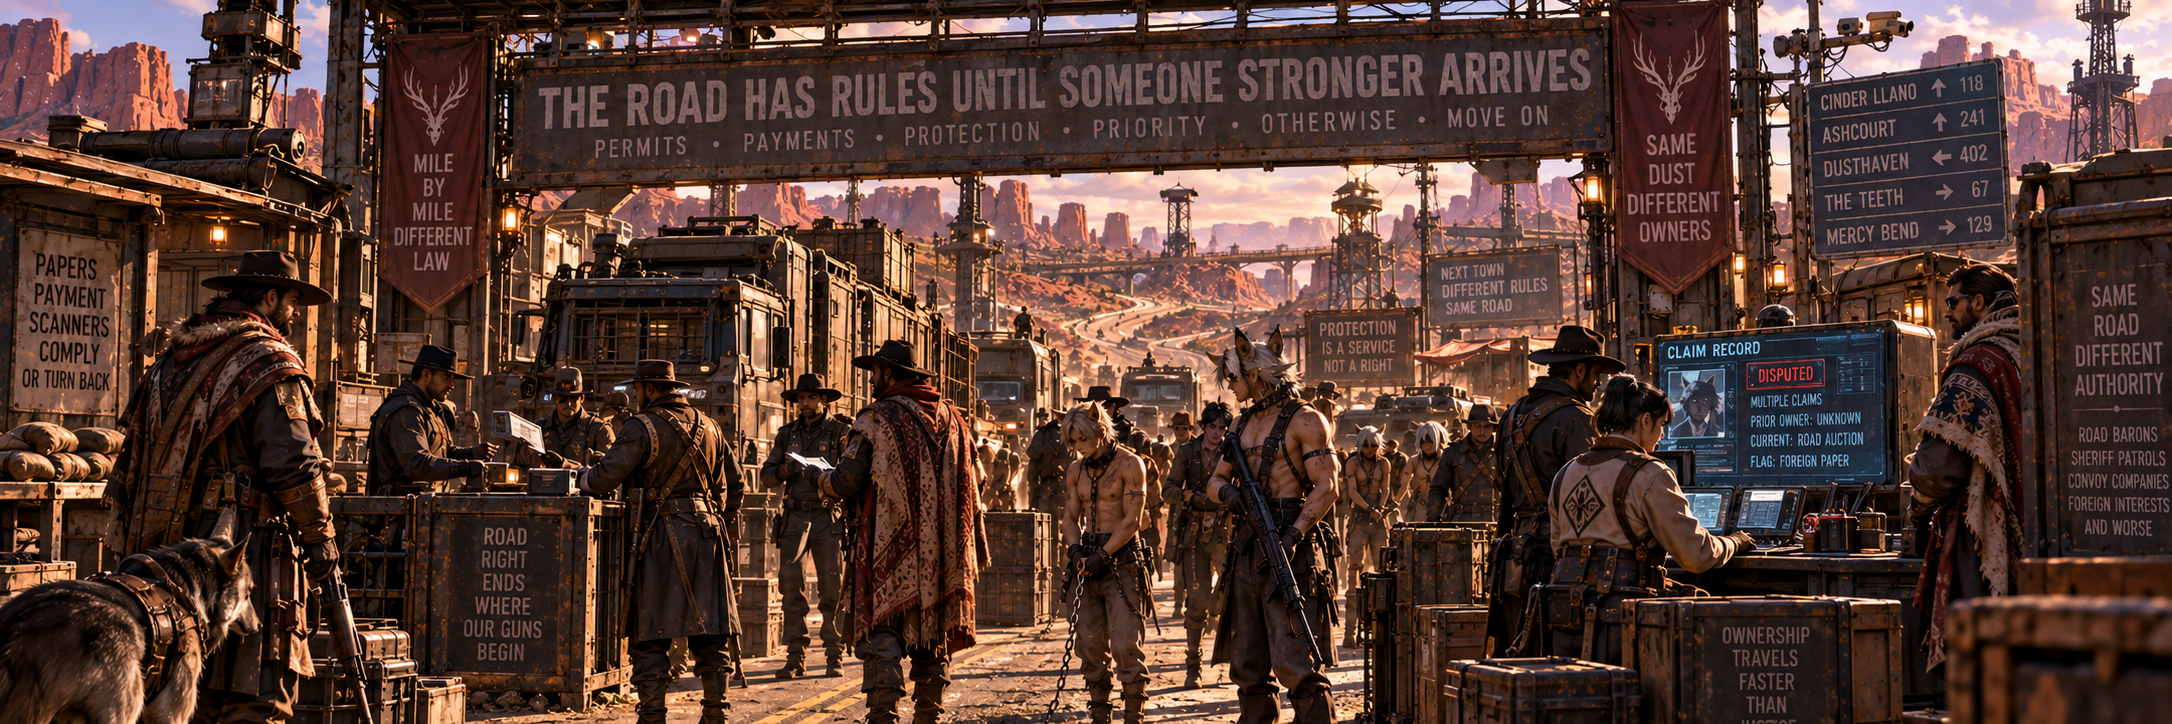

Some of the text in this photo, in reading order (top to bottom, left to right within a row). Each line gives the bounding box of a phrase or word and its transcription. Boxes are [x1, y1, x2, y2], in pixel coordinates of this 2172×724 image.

[538, 48, 1591, 129] THE ROAD HAS RULES UNTIL SOMEONE STRONGER ARRIVES
[1821, 75, 1983, 111] CINDER LLANO 118
[595, 105, 1548, 158] PERMITS PAYMENTS PROTECTION PRIORITY OTHERWISE MOVE ON
[1822, 109, 1984, 143] ASHCOURT 241
[1647, 133, 1696, 156] SAME
[414, 153, 453, 173] MILE
[1824, 144, 1988, 177] DUSTHAVEN 402
[1649, 162, 1695, 185] DUST
[423, 178, 445, 197] BY
[1825, 180, 1989, 212] THE TEETH 67
[413, 202, 453, 221] MILE
[1627, 191, 1720, 215] DIFFERENT
[394, 227, 472, 246] DIFFERENT
[1640, 220, 1711, 242] OWNERS
[1827, 215, 1992, 245] MERCY BEND 129
[36, 253, 97, 280] PAPERS
[414, 252, 450, 271] LAW
[1441, 263, 1504, 280] NEXT TOWN
[34, 283, 106, 309] PAYMENT
[1442, 277, 1547, 298] DIFFERENT RULES
[2091, 284, 2137, 307] SAME
[1446, 298, 1512, 315] SAME ROAD
[29, 311, 109, 337] SCANNERS
[1320, 320, 1396, 336] PROTECTION
[2094, 313, 2139, 337] ROAD
[40, 341, 100, 364] COMPLY
[1322, 340, 1395, 354] IS A SERVICE
[1667, 341, 1760, 359] CLAIM RECORD
[2075, 342, 2163, 367] DIFFERENT
[1324, 359, 1393, 373] NOT A RIGHT
[1758, 366, 1814, 383] DISPUTED
[22, 368, 110, 391] OR TURN BACK
[2075, 372, 2163, 396] AUTHORITY
[1751, 394, 1789, 409] MULTIPLE
[1792, 393, 1822, 407] CLAIMS
[1751, 412, 1861, 427] PRIOR OWNER: UNKNOWN
[1751, 432, 1863, 447] CURRENT: ROAD AUCTION
[2079, 426, 2158, 442] ROAD BARONS
[1751, 454, 1849, 468] FLAG: FOREIGN PAPER
[2071, 450, 2166, 466] SHERIFF PATROLS
[2068, 473, 2169, 489] CONVOY COMPANIES
[2068, 496, 2170, 513] FOREIGN INTERESTS
[484, 527, 527, 545] ROAD
[2084, 519, 2152, 536] AND WORSE
[482, 550, 528, 568] RIGHT
[483, 573, 525, 591] ENDS
[475, 596, 531, 615] WHERE
[464, 619, 542, 638] OUR GUNS
[1723, 627, 1810, 644] OWNERSHIP
[477, 643, 524, 661] BEGIN
[1732, 649, 1798, 667] TRAVELS
[1740, 673, 1794, 690] FASTER
[1746, 696, 1786, 714] THAN
